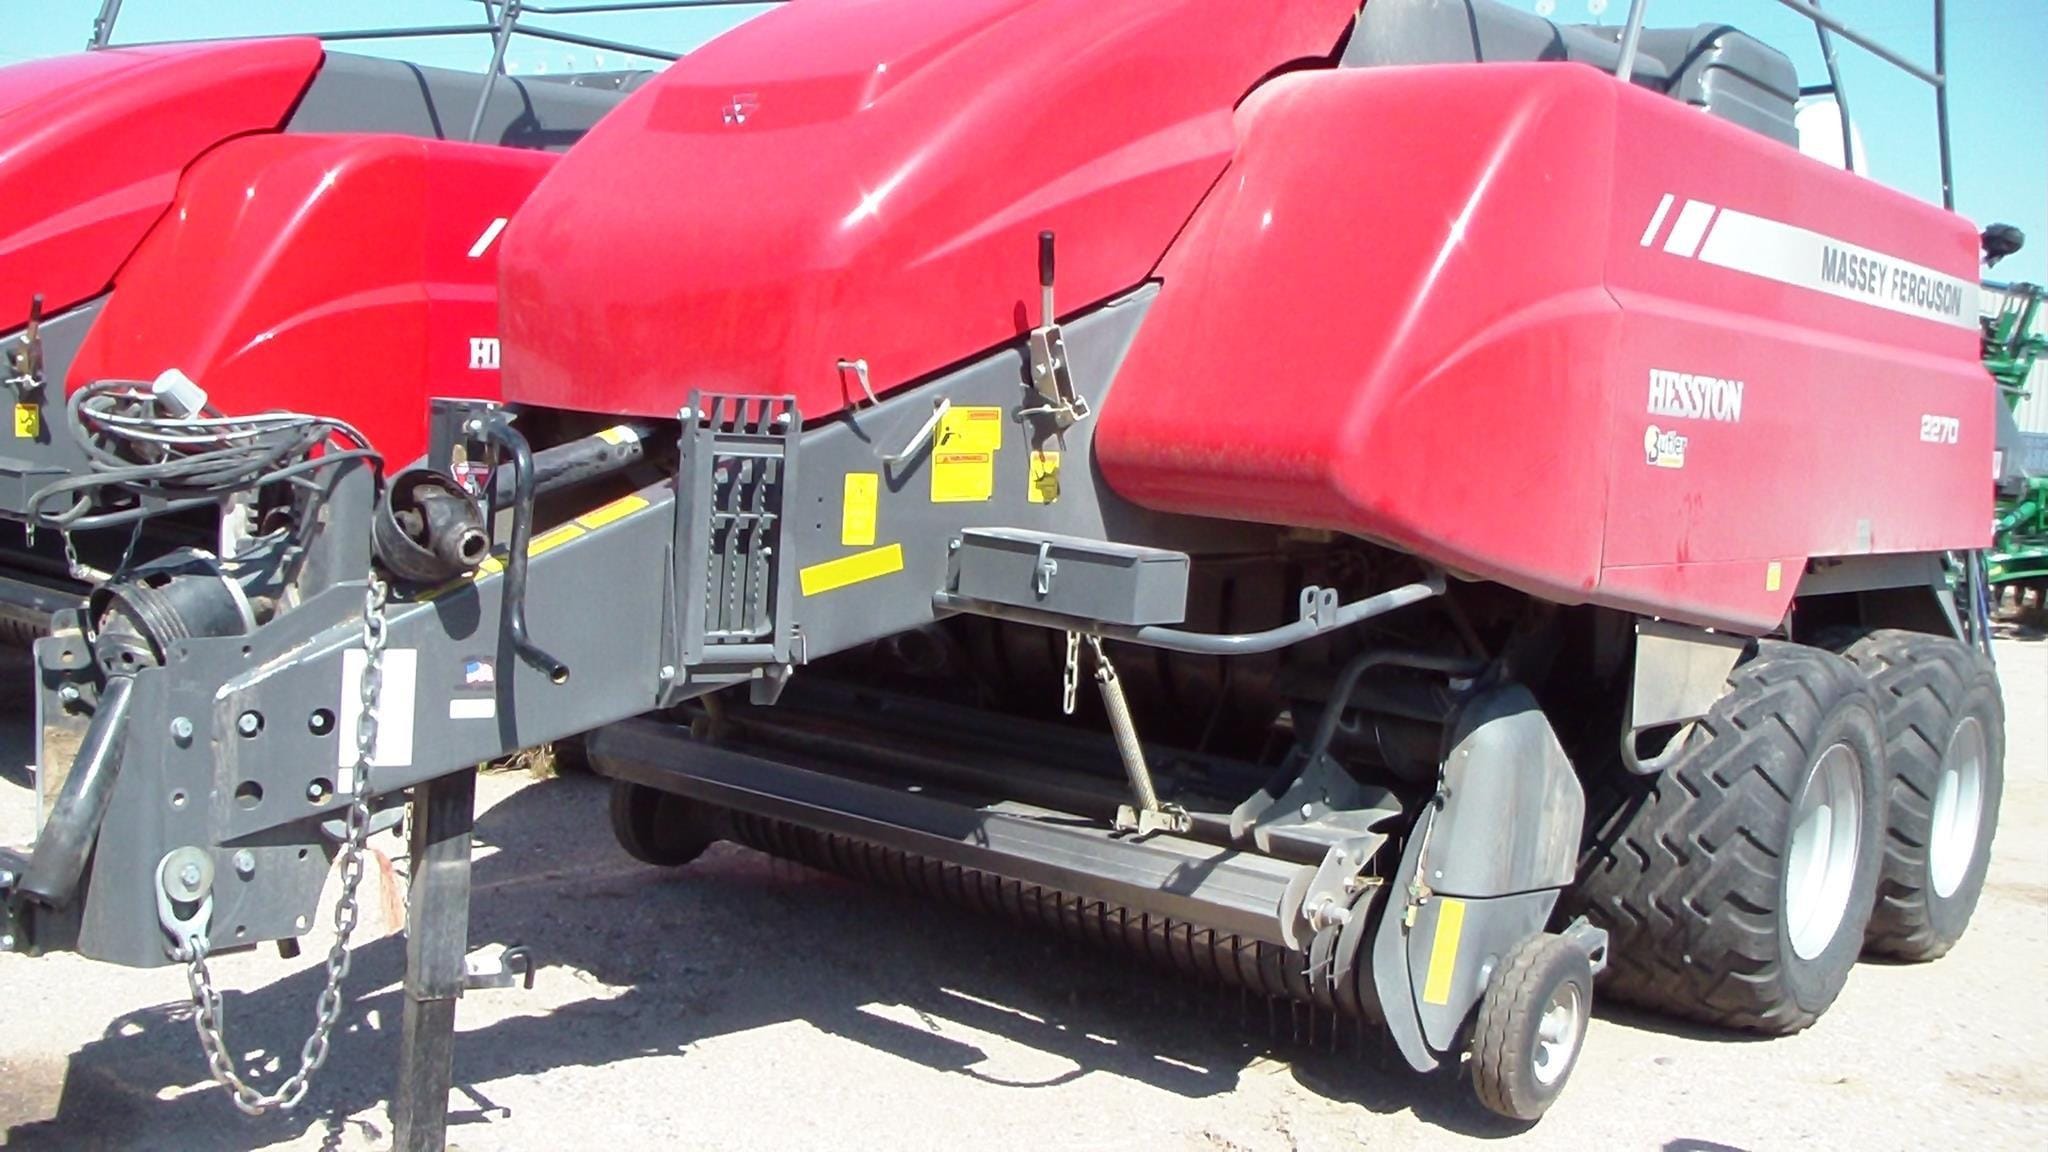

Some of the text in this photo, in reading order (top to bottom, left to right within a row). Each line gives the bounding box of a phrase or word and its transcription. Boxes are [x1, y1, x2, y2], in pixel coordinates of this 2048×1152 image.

[1821, 245, 1963, 317] MASSEY FERGUSON
[1647, 368, 1744, 422] HESSTON
[1920, 414, 1960, 444] 2270
